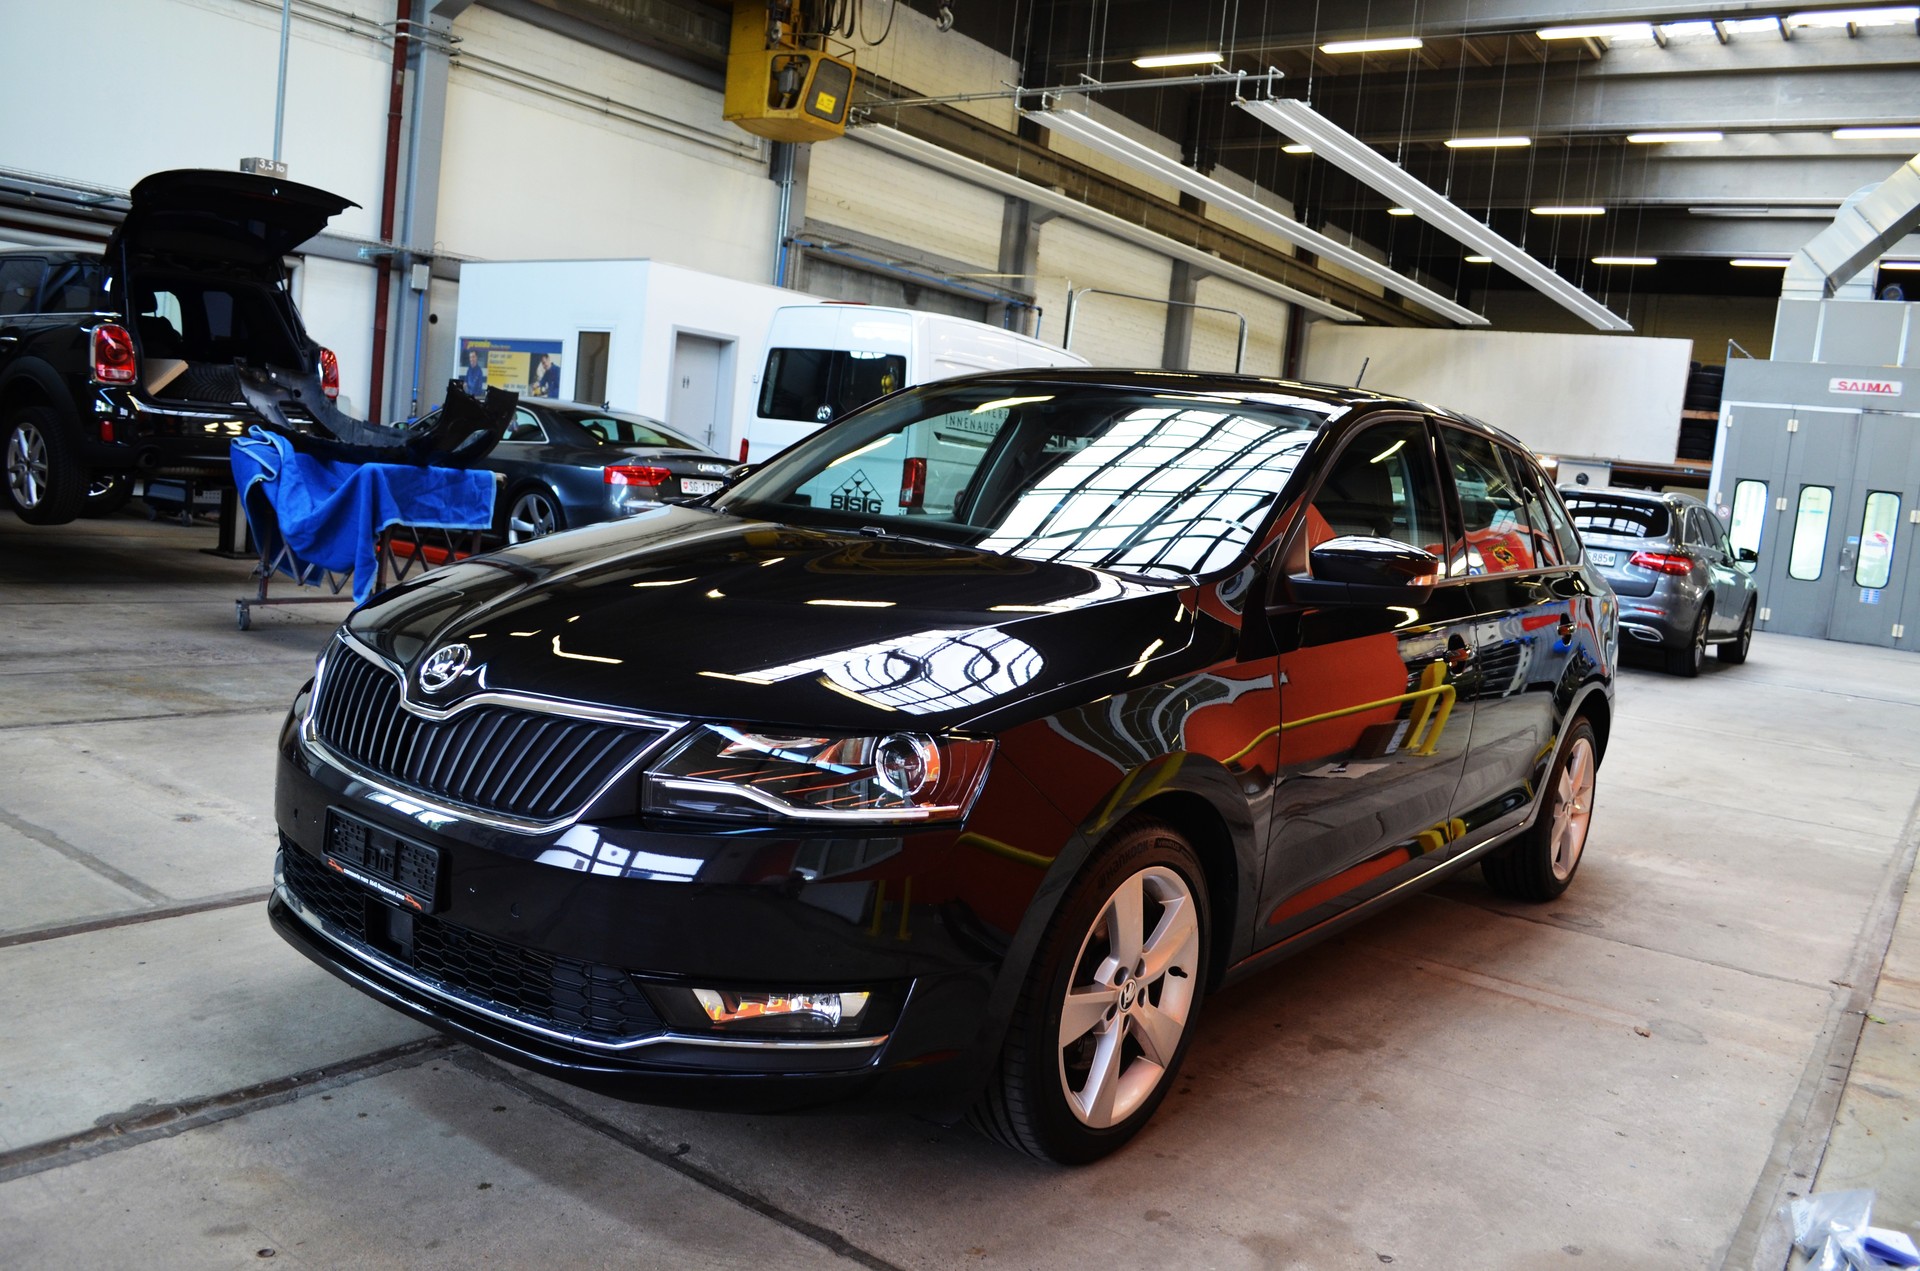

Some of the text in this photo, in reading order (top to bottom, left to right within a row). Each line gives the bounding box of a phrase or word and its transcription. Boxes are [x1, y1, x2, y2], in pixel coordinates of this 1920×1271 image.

[259, 158, 274, 171] 3,5
[1838, 381, 1893, 393] SAIMA
[831, 495, 882, 514] BISIG
